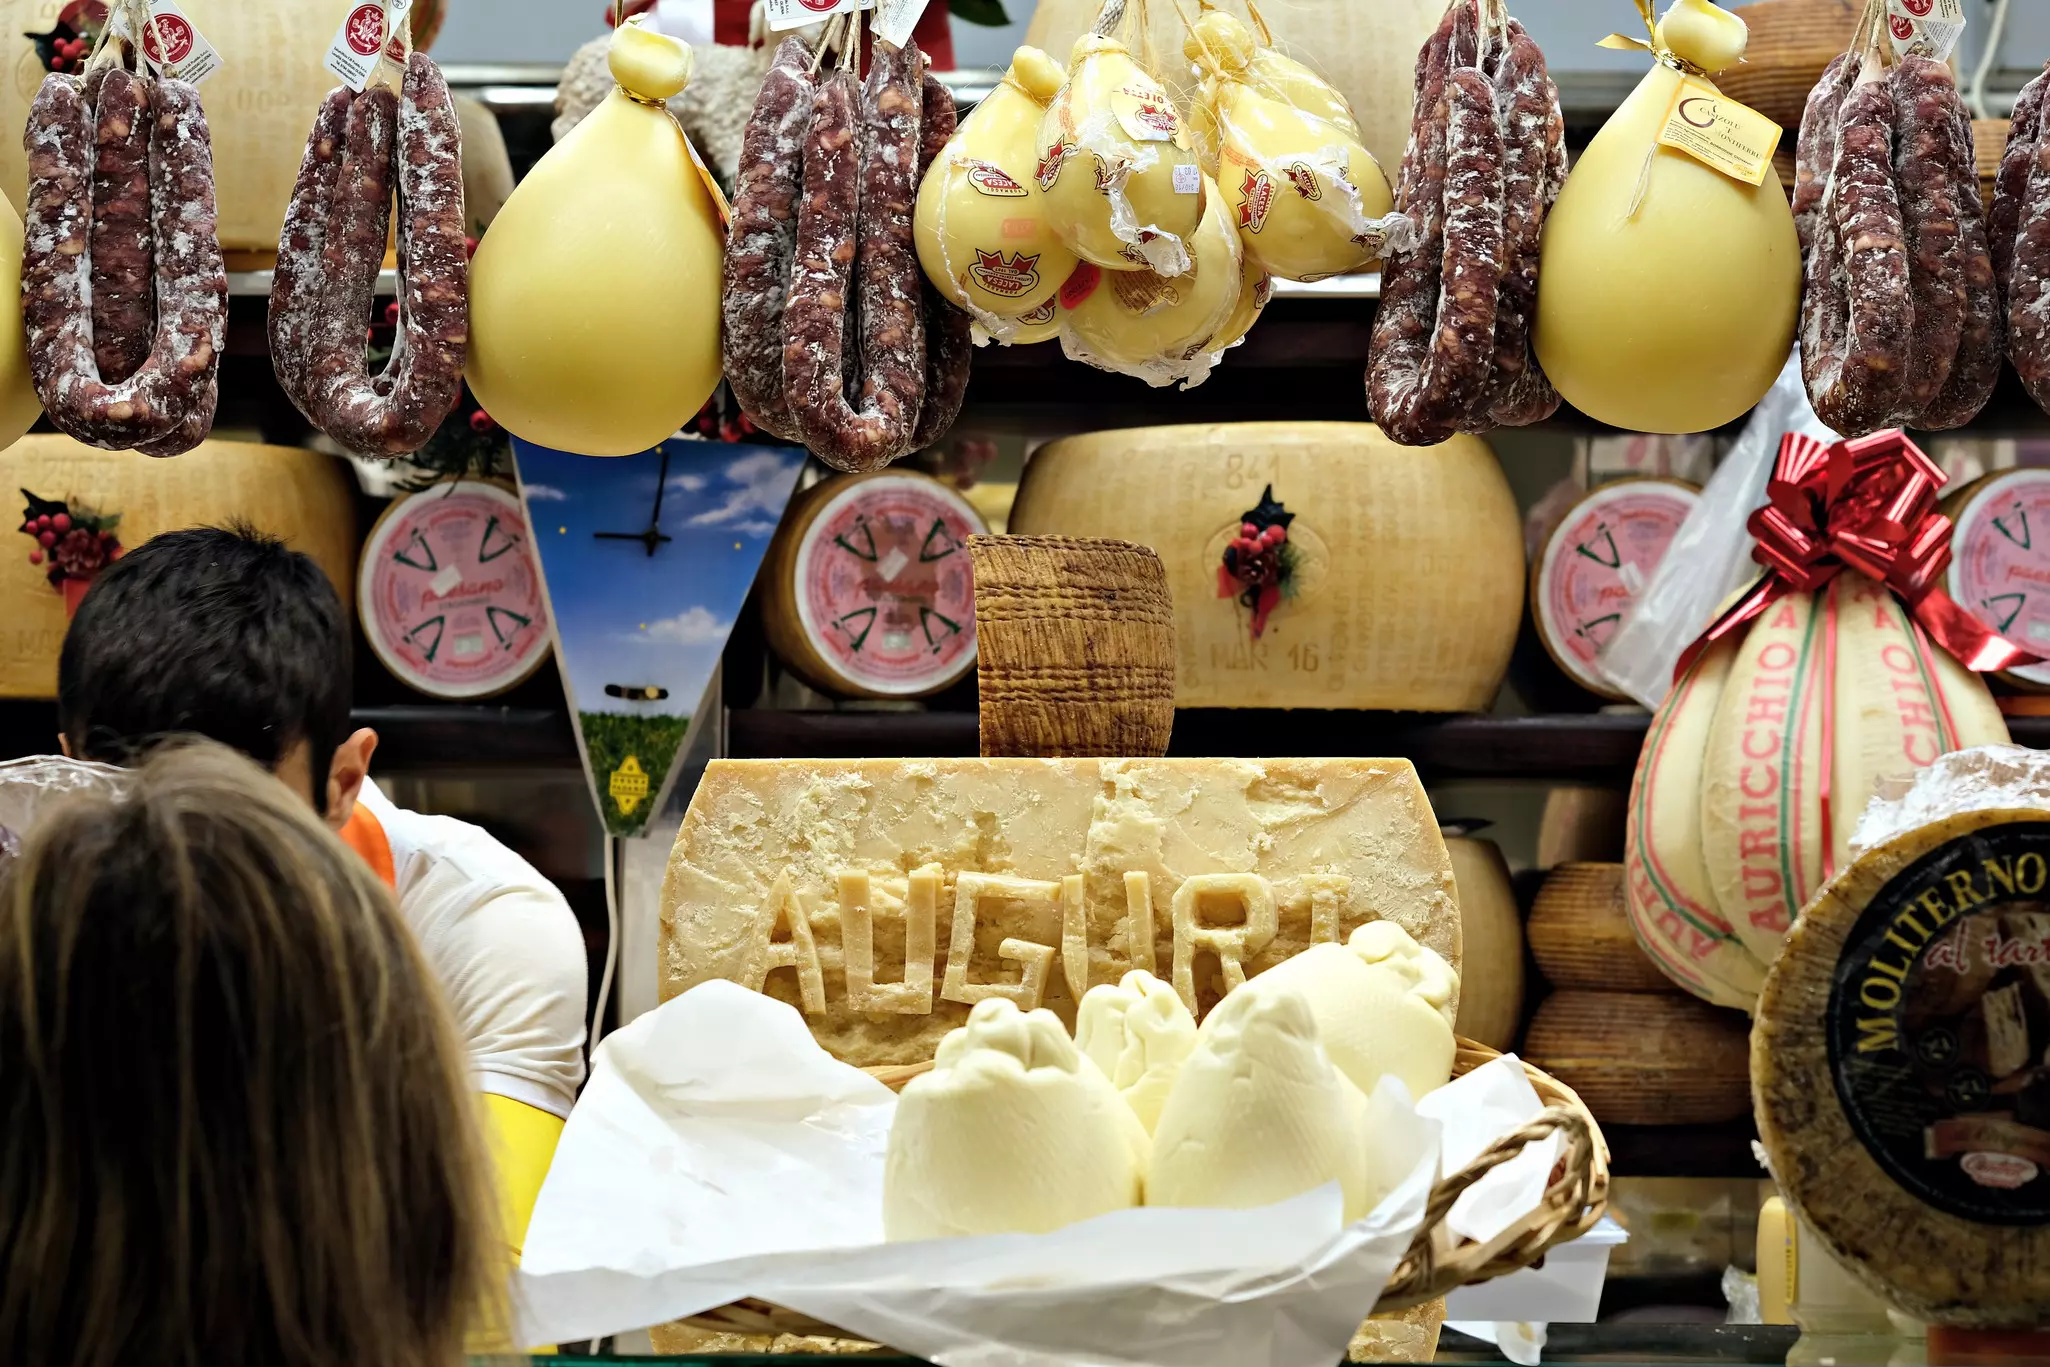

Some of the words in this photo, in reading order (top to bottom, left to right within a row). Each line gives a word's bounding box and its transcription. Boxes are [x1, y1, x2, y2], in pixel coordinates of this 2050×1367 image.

[1257, 186, 1270, 216] LACESA
[986, 276, 1020, 289] LACESA
[1739, 641, 1797, 934] AURICCHIO
[1856, 852, 2048, 1054] MOLITERNO
